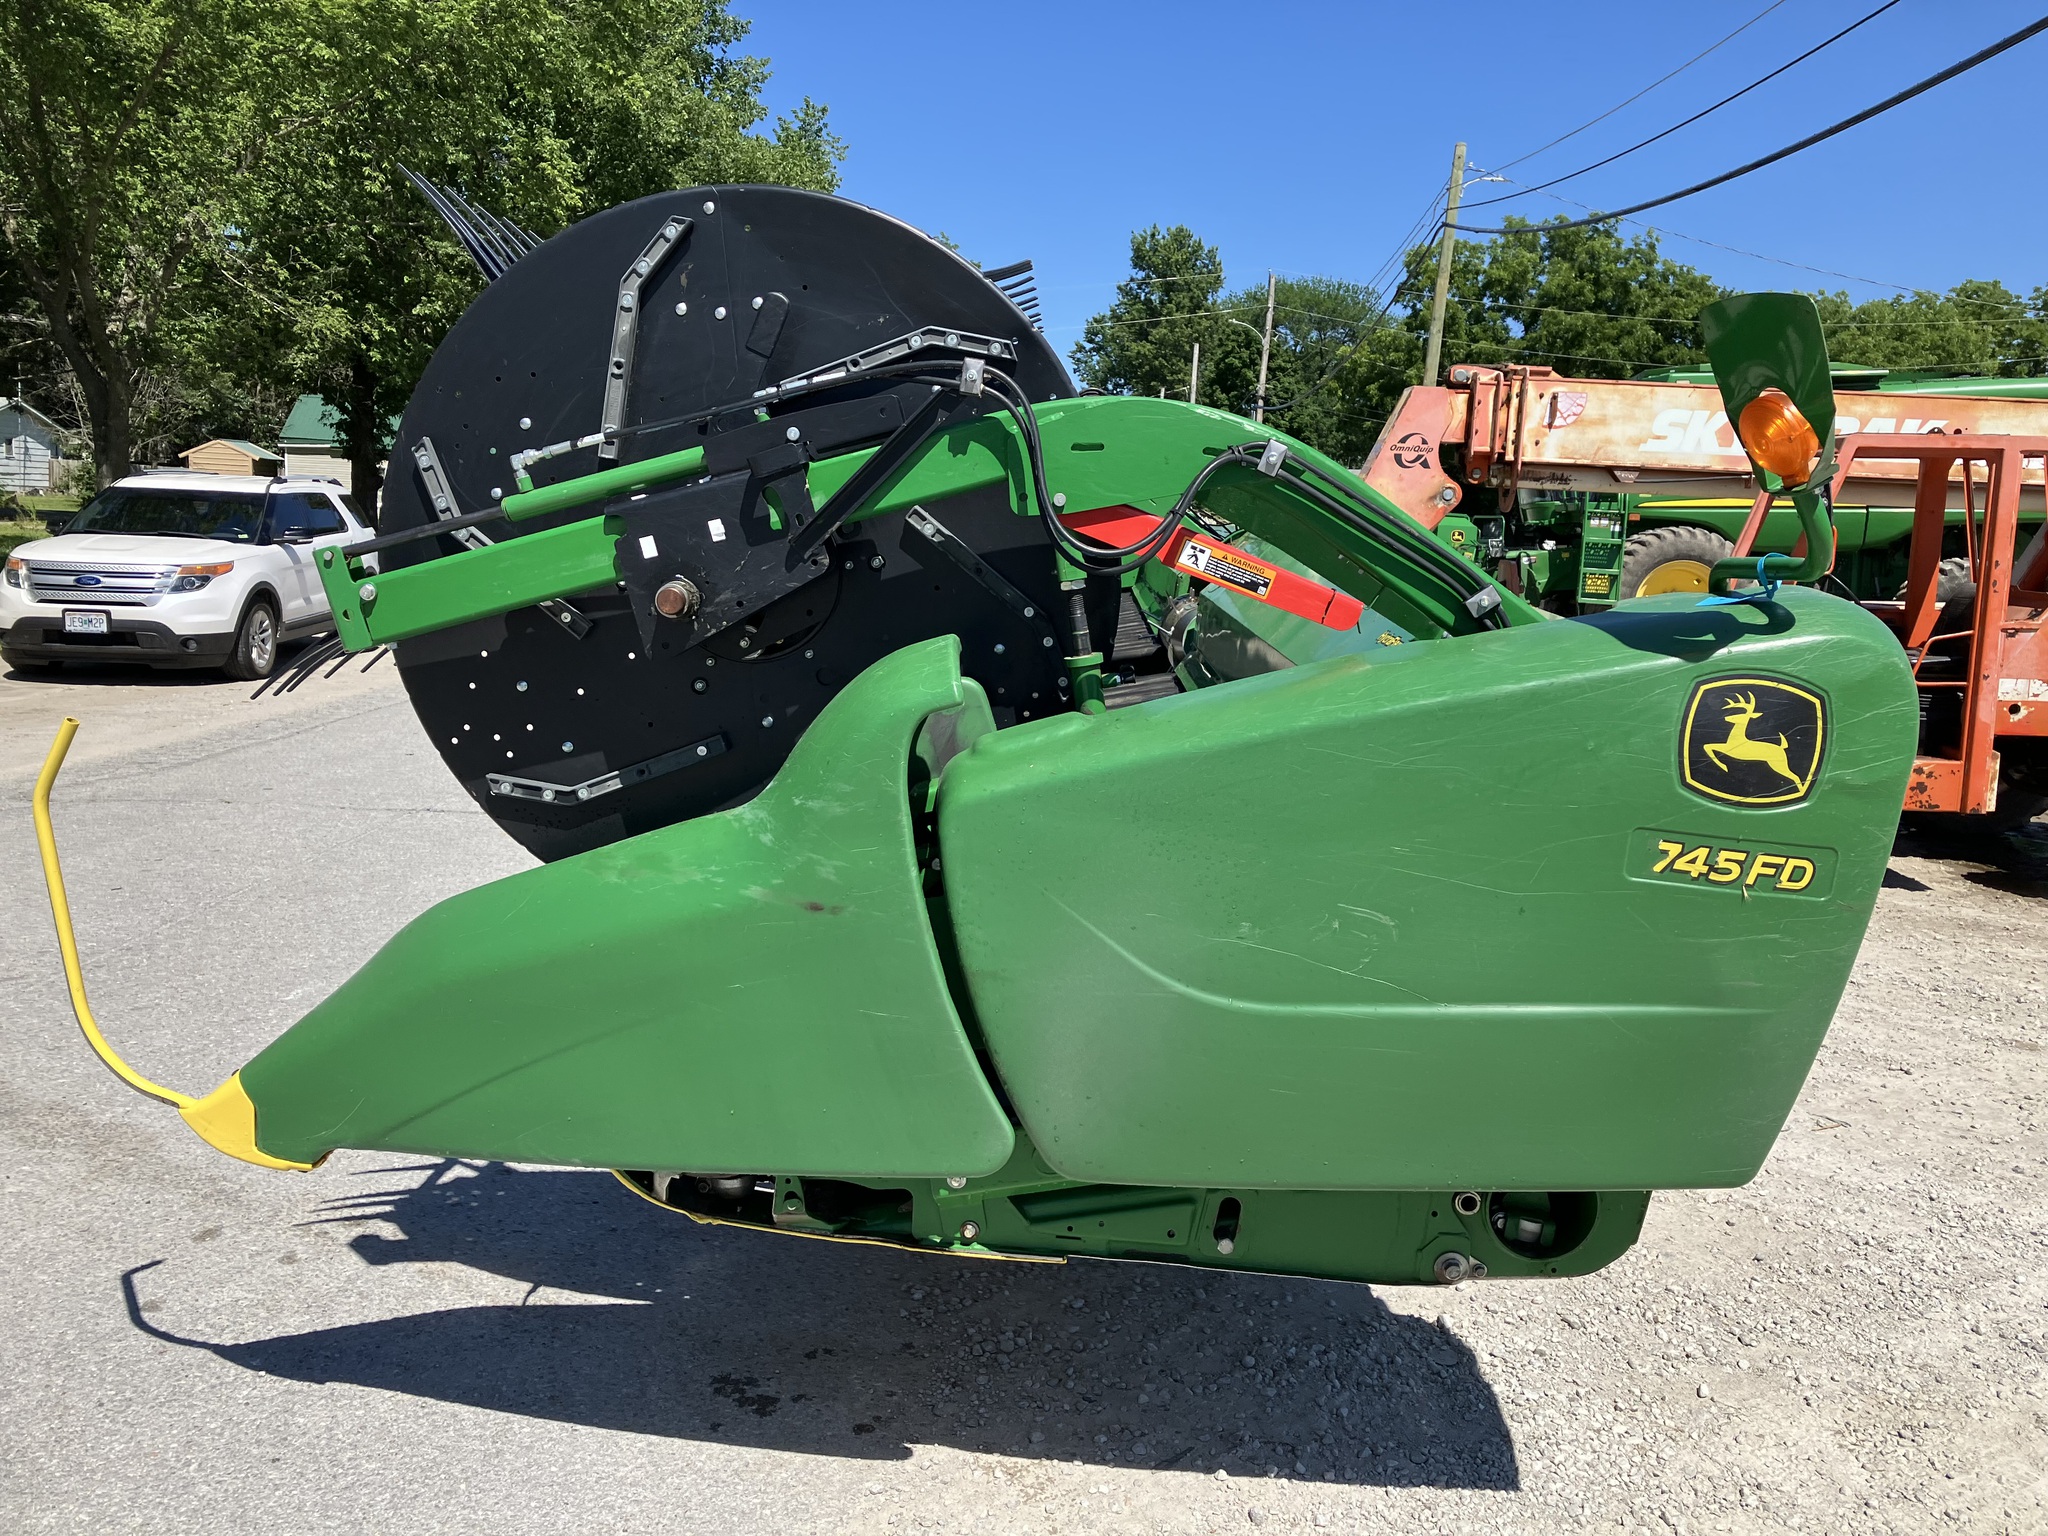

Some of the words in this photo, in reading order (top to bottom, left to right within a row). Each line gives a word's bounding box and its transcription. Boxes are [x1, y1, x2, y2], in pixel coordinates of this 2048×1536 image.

[1390, 444, 1434, 454] OmniQuip
[1231, 556, 1266, 575] WARNING
[1652, 839, 1816, 891] 745FD
